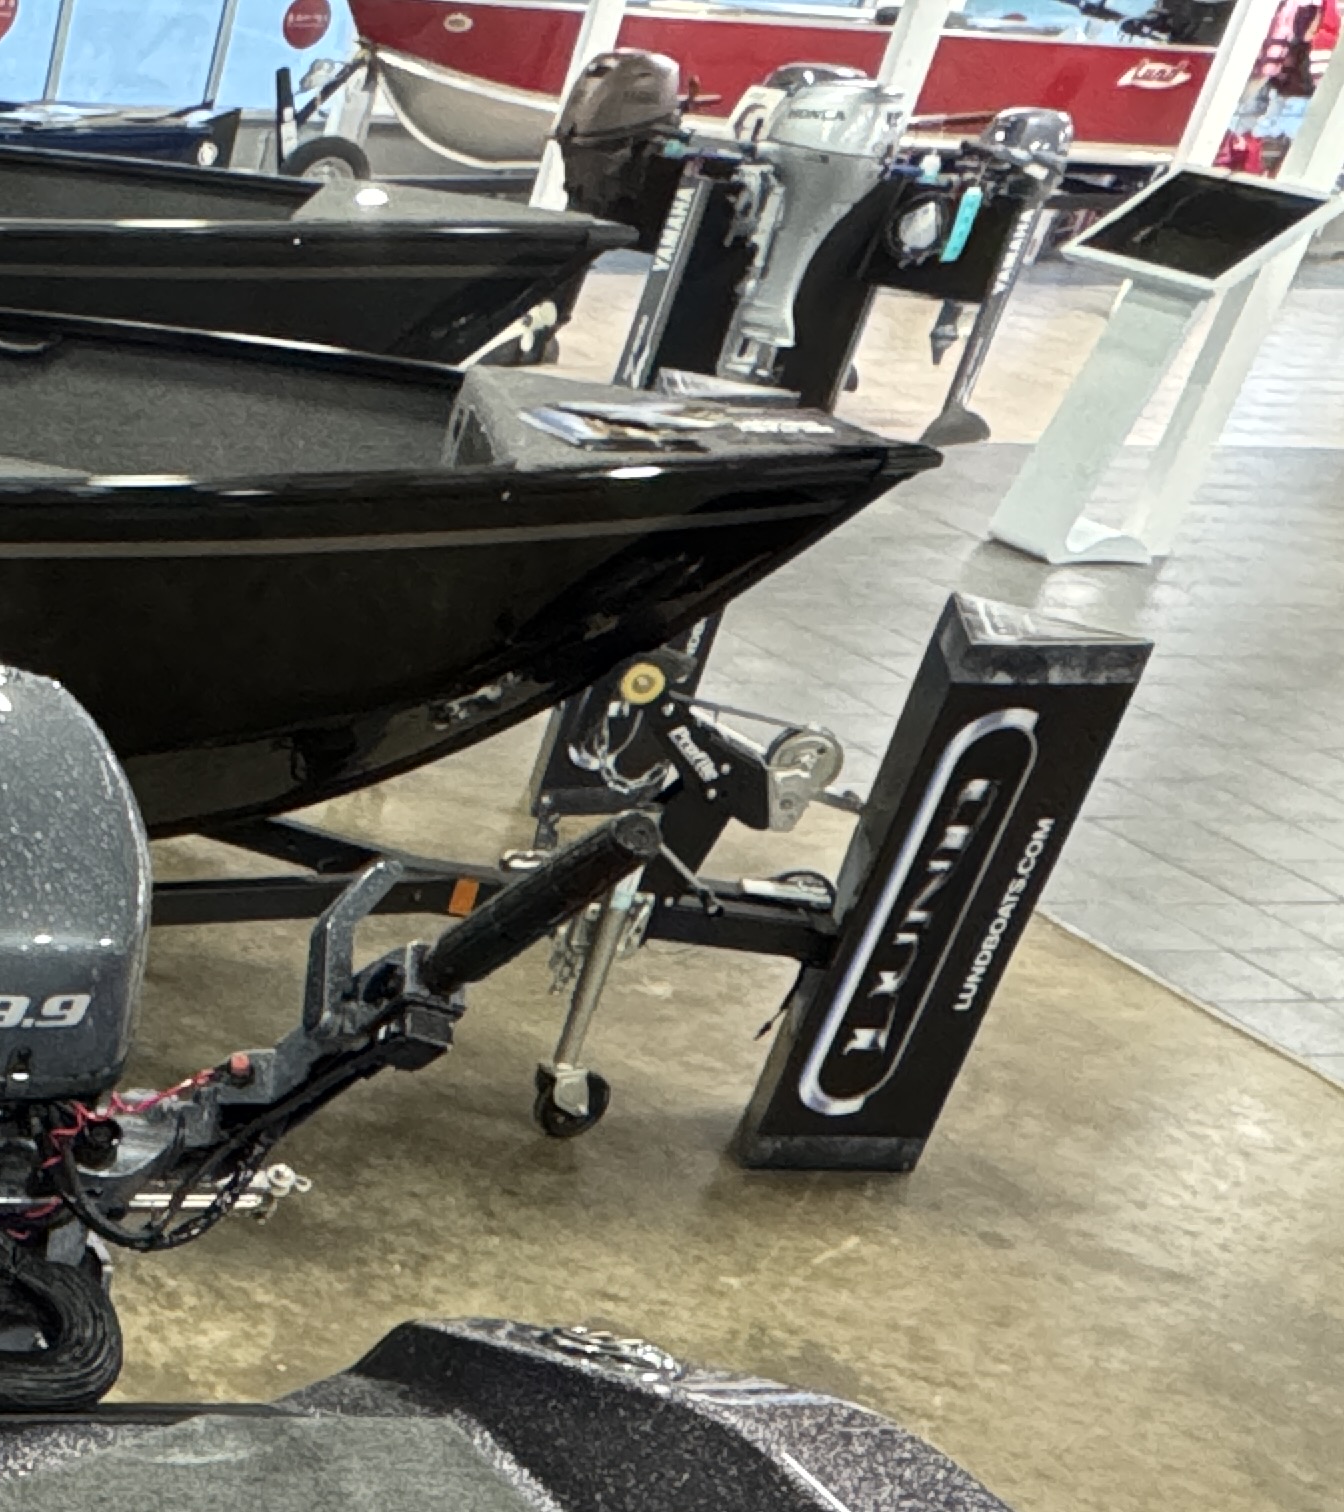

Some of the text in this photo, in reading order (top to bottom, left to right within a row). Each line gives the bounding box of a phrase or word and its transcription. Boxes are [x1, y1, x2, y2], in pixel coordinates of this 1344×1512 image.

[652, 187, 697, 272] YAMAHA
[991, 208, 1035, 296] YAMAHA
[842, 778, 1001, 1056] LUND
[952, 816, 1056, 1012] LUNDBOATS.COM
